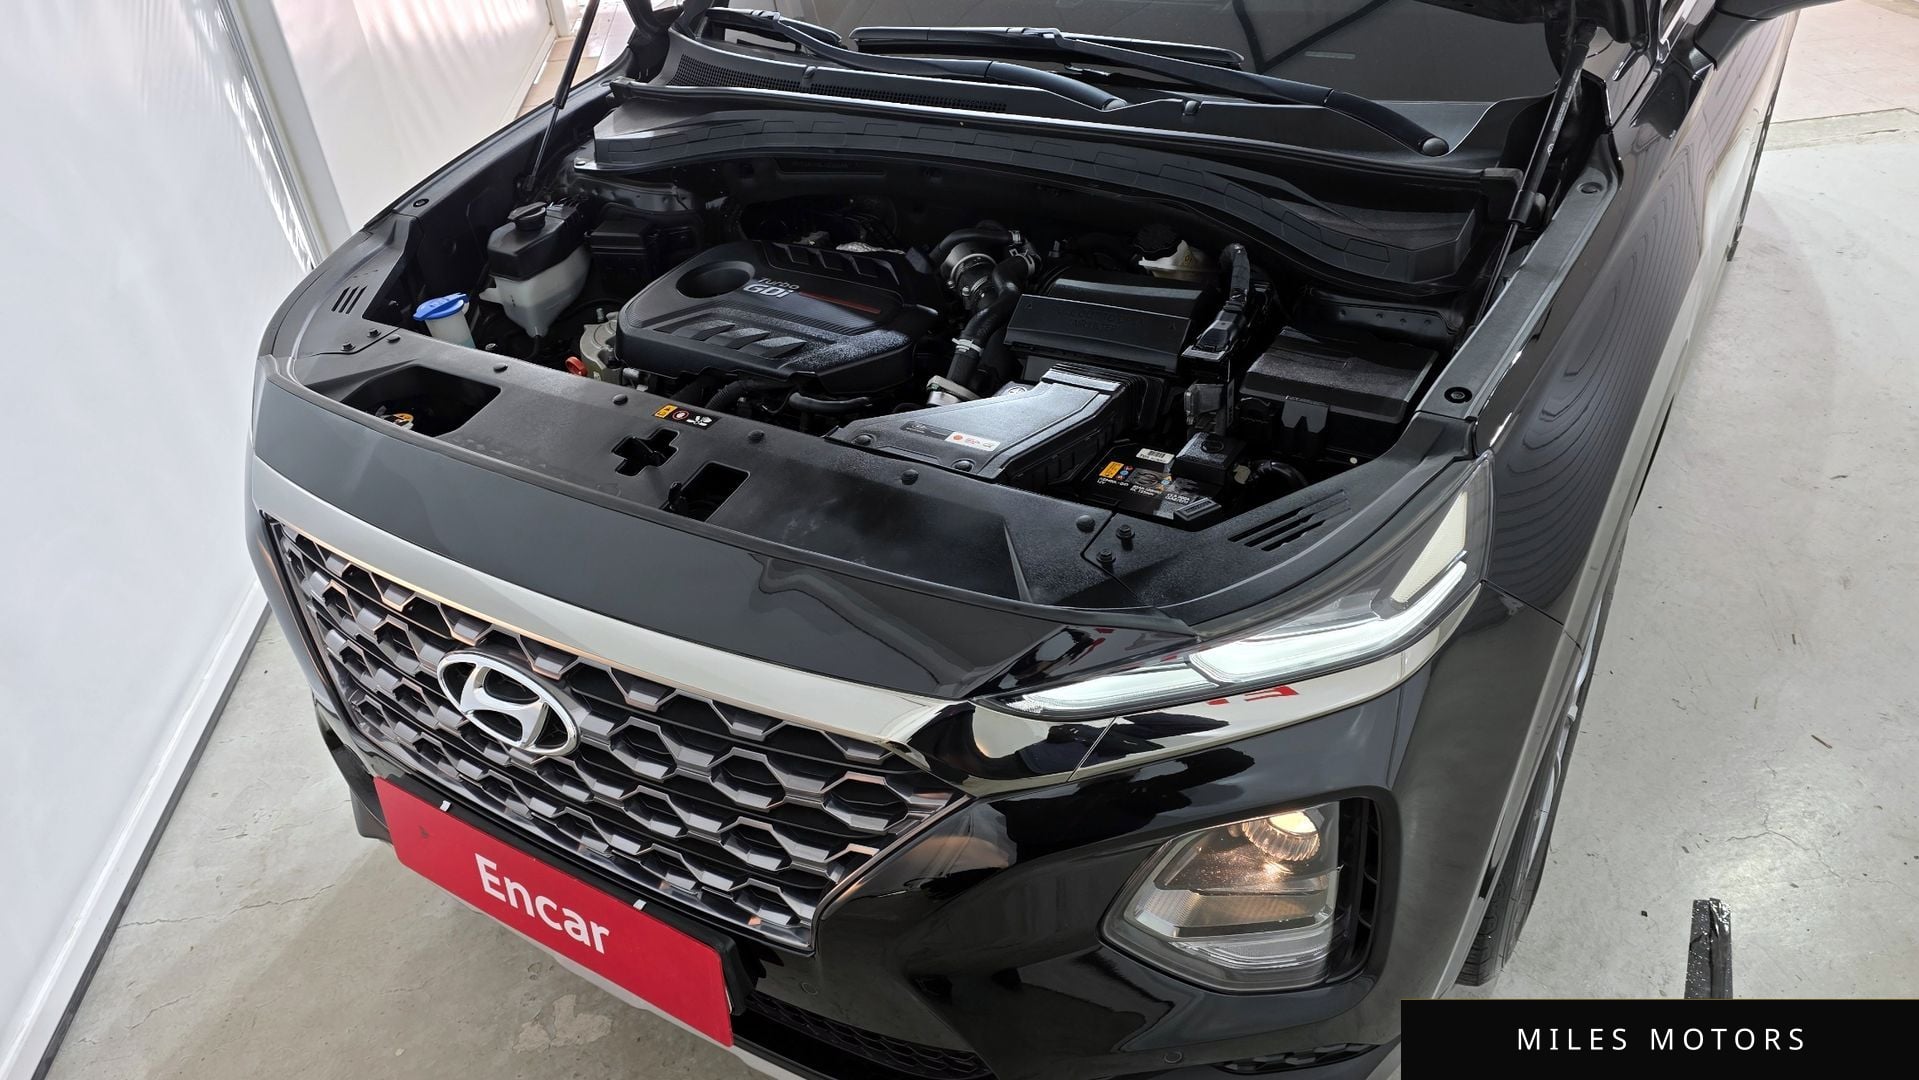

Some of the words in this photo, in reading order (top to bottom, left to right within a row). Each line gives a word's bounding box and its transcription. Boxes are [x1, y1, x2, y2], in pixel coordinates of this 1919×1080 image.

[743, 283, 794, 298] GDi
[758, 277, 800, 290] Turbo
[474, 852, 610, 955] Encar
